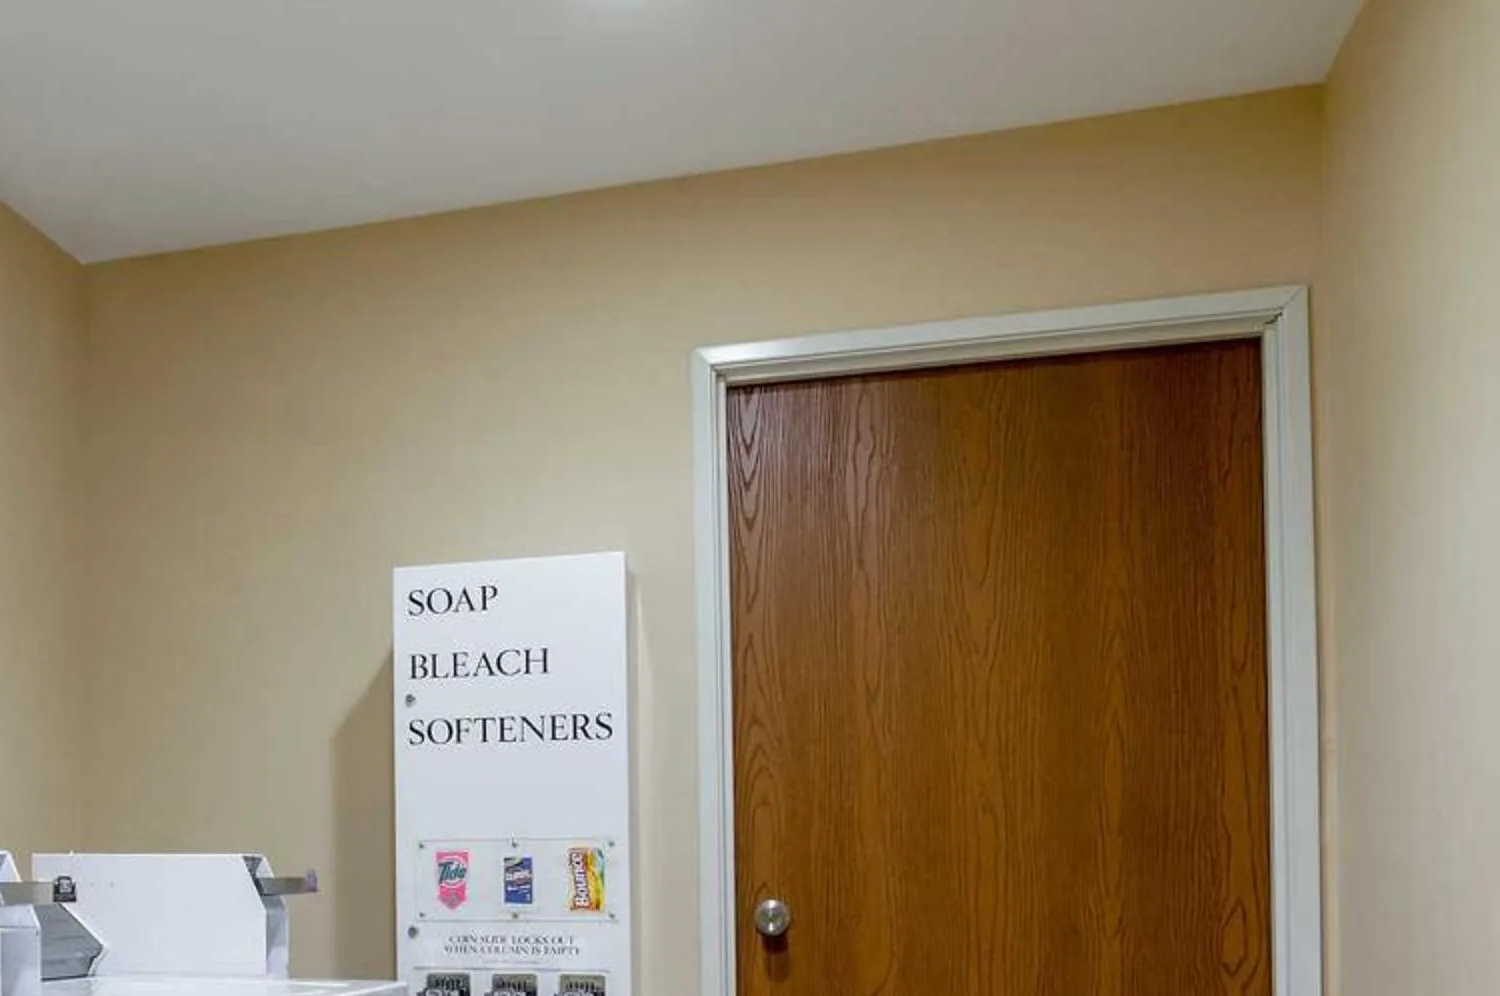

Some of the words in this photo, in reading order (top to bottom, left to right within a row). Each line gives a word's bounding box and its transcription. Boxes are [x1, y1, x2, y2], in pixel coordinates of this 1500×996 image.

[407, 585, 499, 617] SOAP
[409, 648, 549, 680] BLEACH
[408, 712, 613, 746] SOFTENERS
[438, 861, 467, 884] Tide
